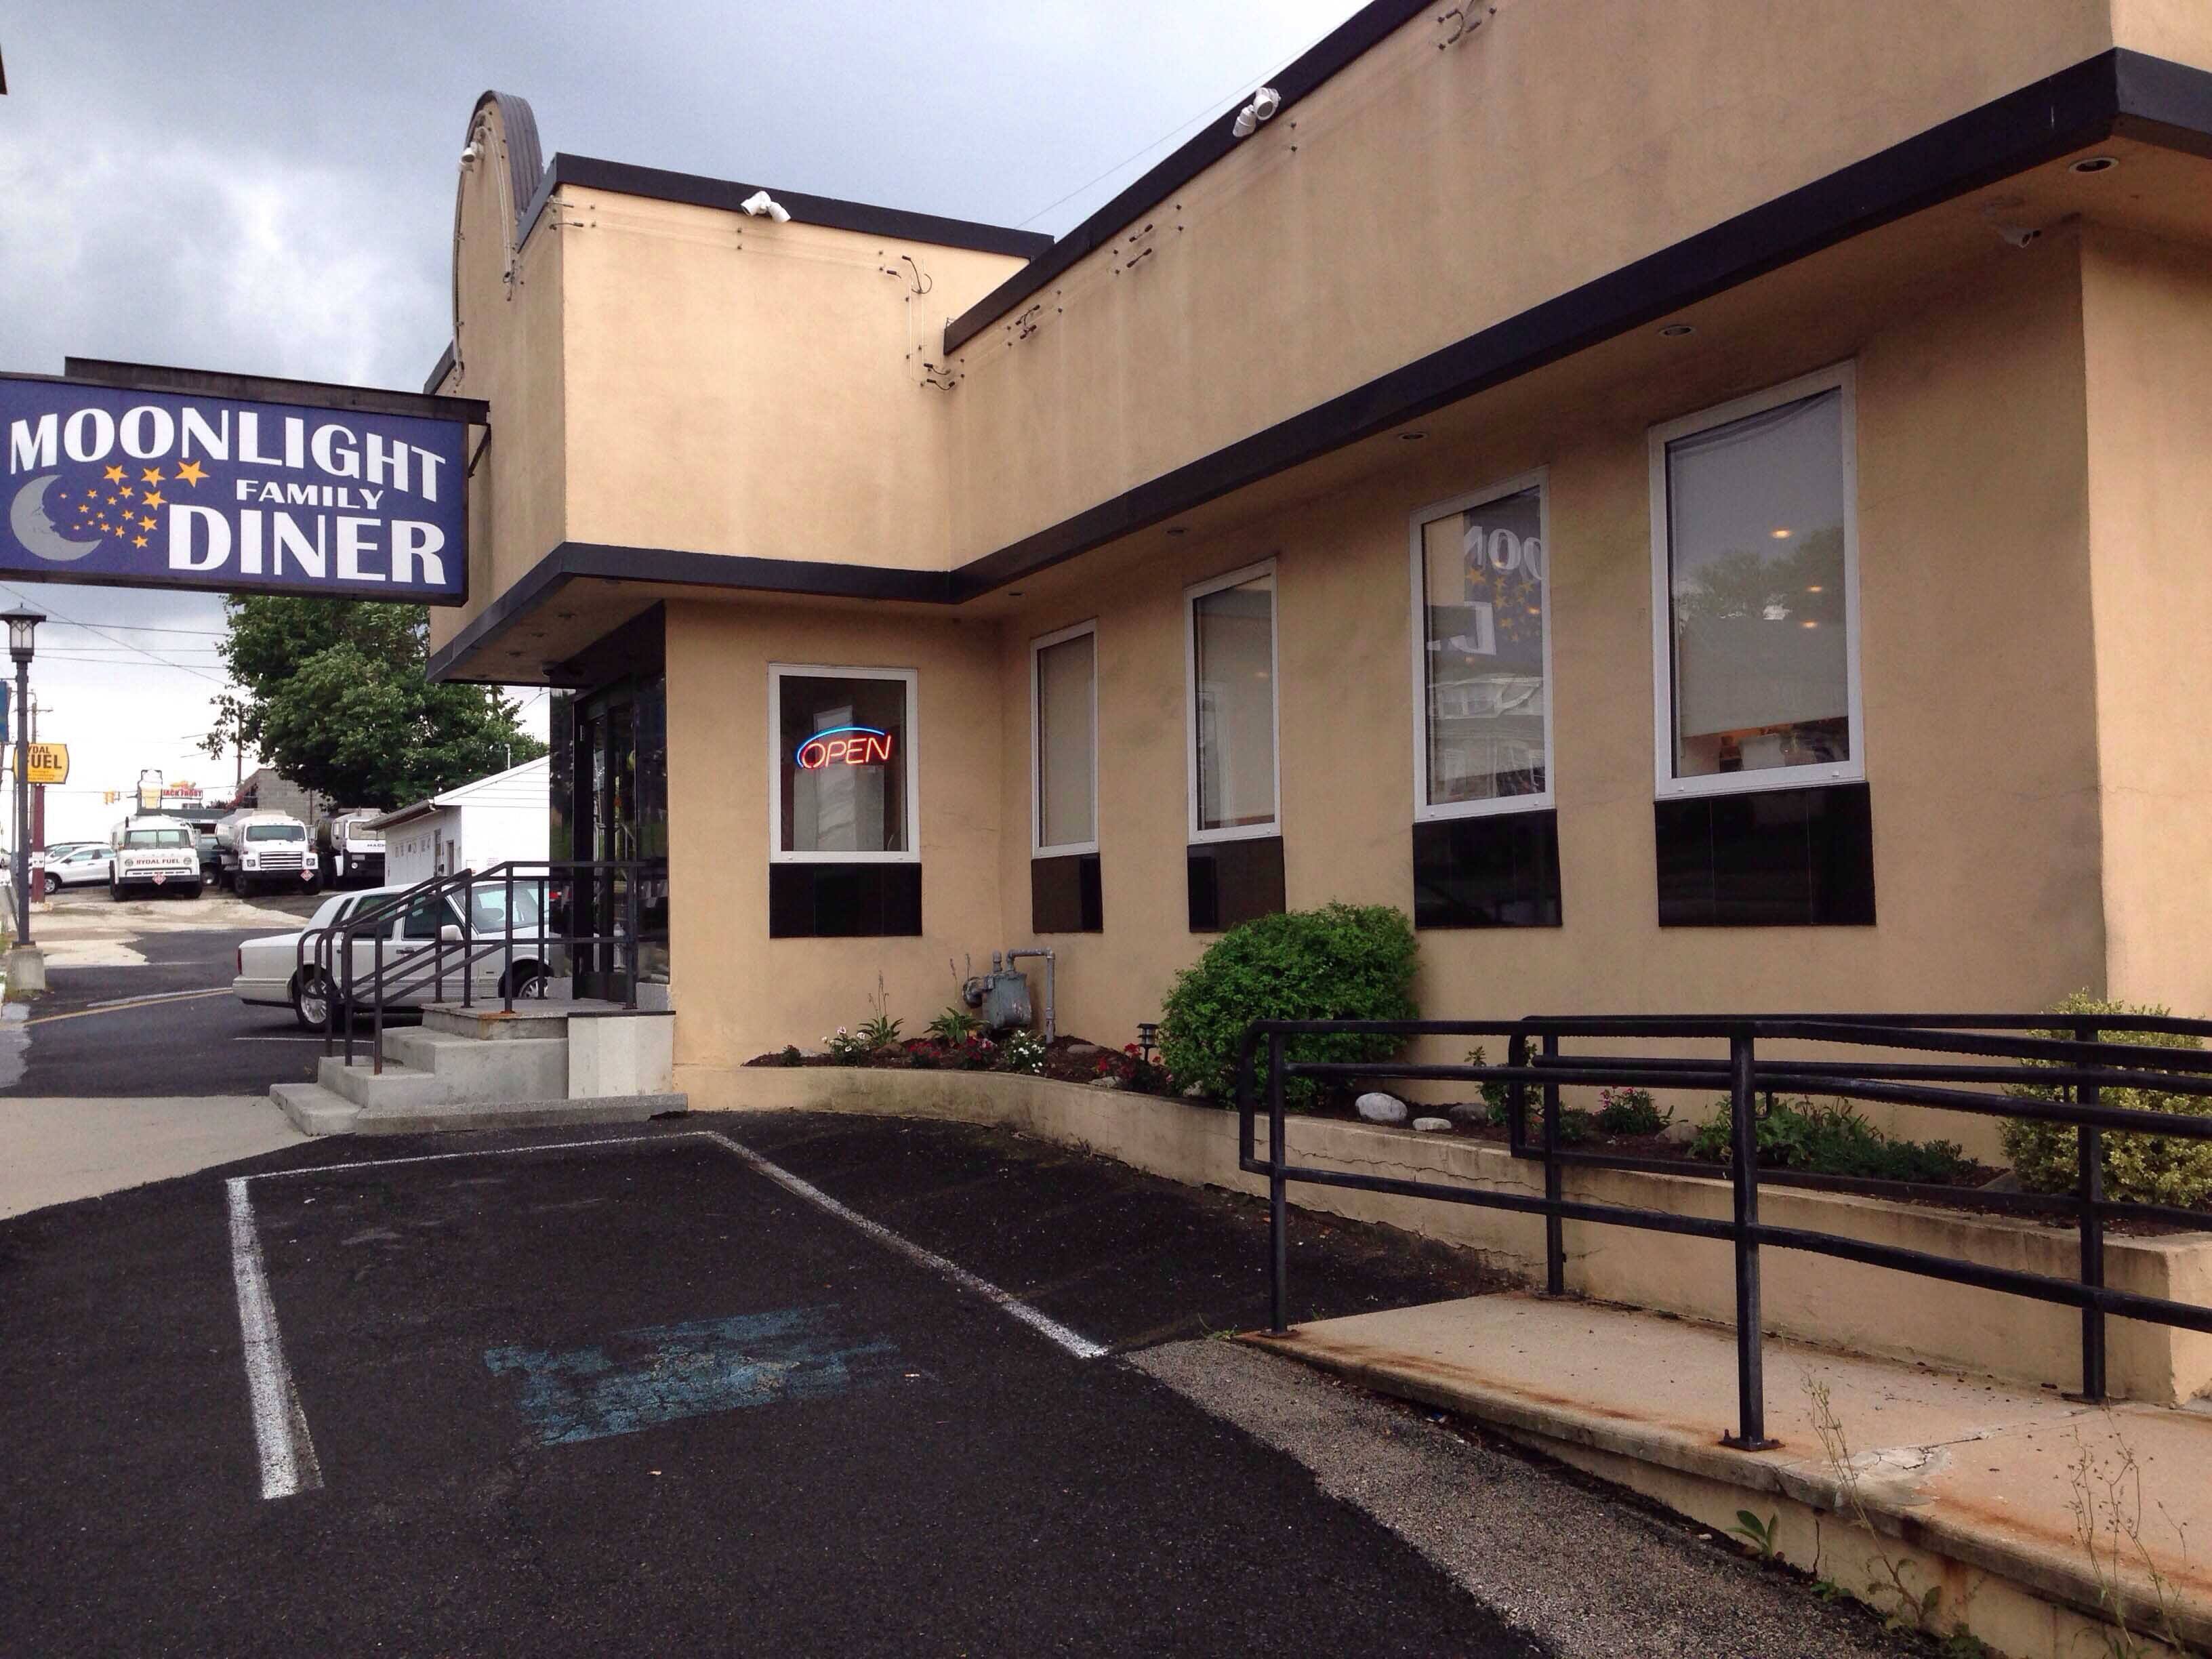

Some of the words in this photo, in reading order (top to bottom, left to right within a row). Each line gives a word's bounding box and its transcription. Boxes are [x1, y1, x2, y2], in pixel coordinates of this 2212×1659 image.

[10, 406, 446, 503] MOONLIGHT
[235, 478, 384, 510] FAMILY
[168, 504, 447, 585] DINER
[27, 754, 62, 769] UEL
[802, 735, 892, 769] OPEN
